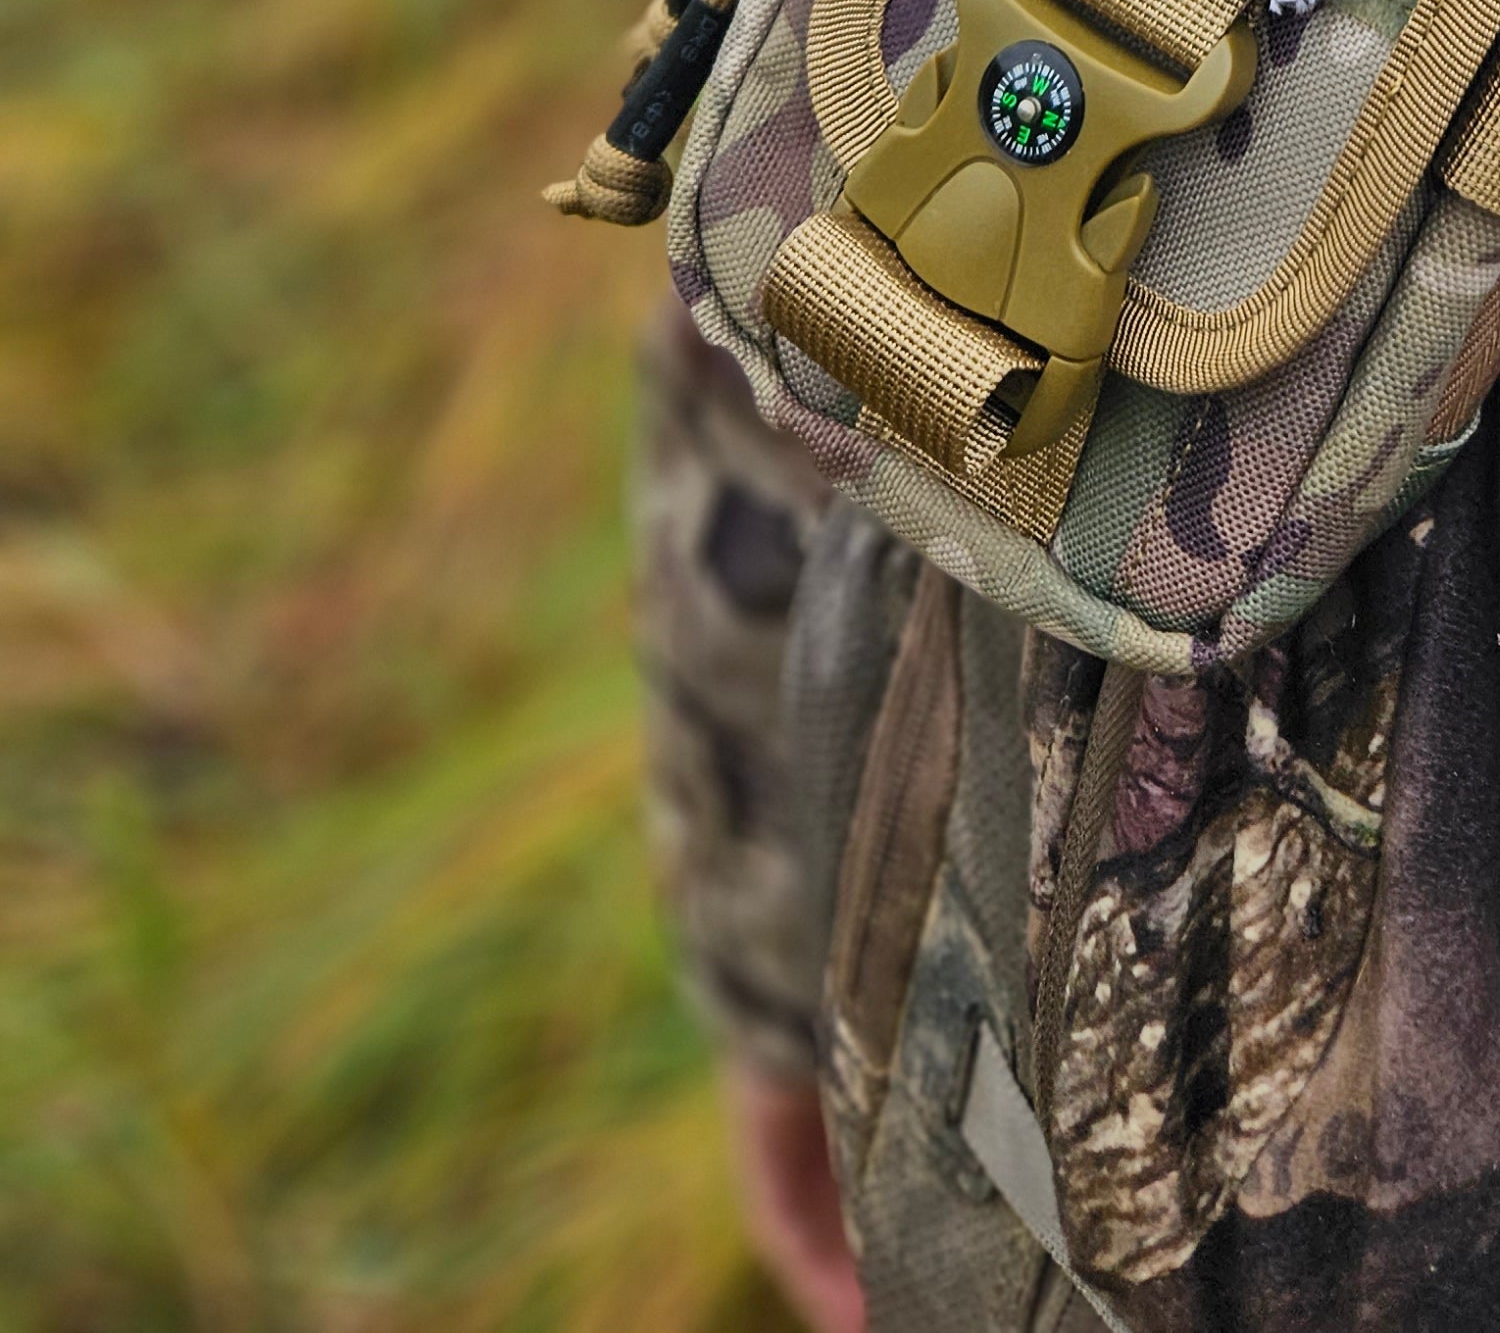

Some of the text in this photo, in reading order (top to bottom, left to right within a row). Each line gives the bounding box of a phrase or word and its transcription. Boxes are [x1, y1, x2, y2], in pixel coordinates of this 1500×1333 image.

[1032, 74, 1050, 97] W
[1002, 92, 1017, 108] S
[1042, 110, 1059, 128] N
[1016, 125, 1031, 144] E
